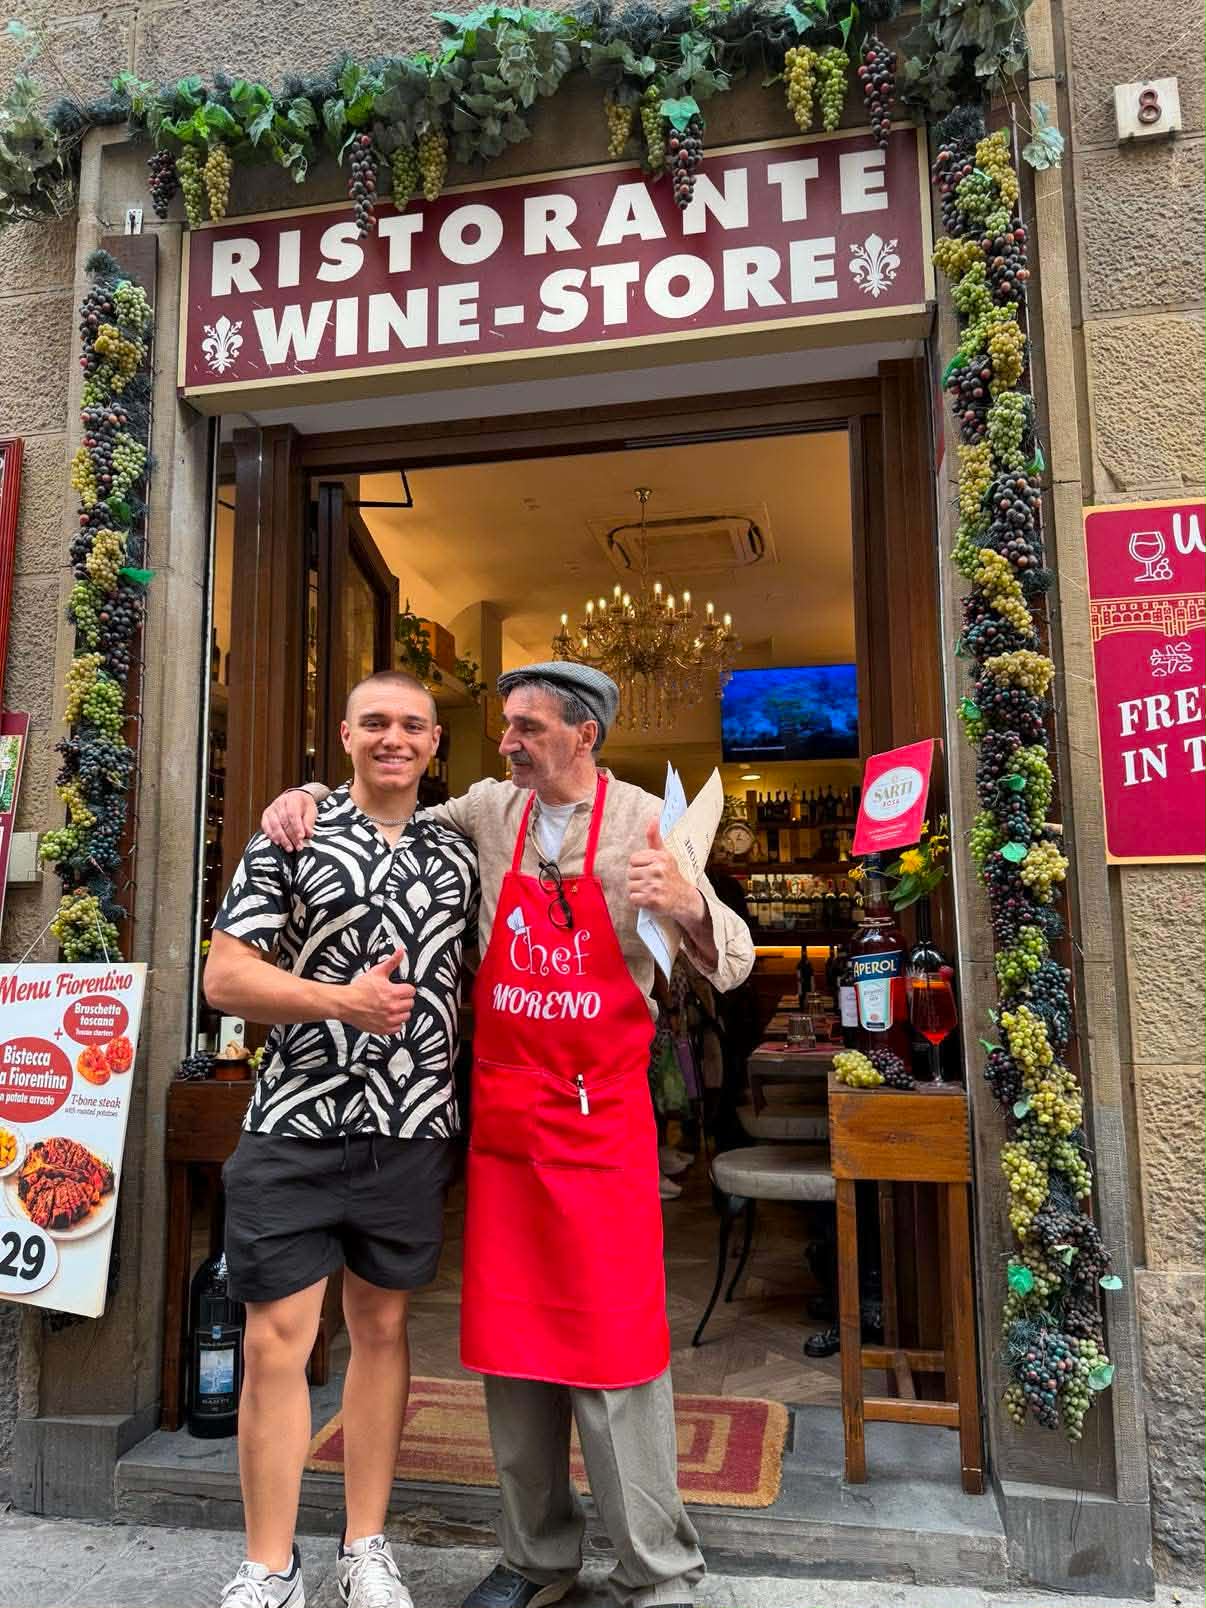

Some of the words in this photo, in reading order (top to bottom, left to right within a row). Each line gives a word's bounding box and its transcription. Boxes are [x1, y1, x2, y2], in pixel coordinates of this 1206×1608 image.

[1138, 89, 1162, 124] 8
[211, 148, 890, 298] RISTORANTE
[252, 236, 839, 366] WINE-STORE
[1117, 684, 1206, 737] FRE
[1121, 743, 1169, 787] IN
[873, 781, 913, 802] SARTI
[509, 926, 591, 977] Chef
[853, 959, 897, 978] APEROL
[0, 974, 52, 1005] Menu
[56, 968, 134, 998] Fiorentino
[492, 983, 602, 1020] MORENO
[74, 1002, 122, 1016] Bruschetta
[79, 1013, 115, 1027] toscana
[3, 1044, 51, 1067] Bistecca
[8, 1066, 68, 1090] Fiorentina
[29, 1094, 55, 1106] arrosto
[71, 1093, 97, 1107] T-bone
[98, 1096, 121, 1109] steak
[0, 1231, 46, 1280] 29
